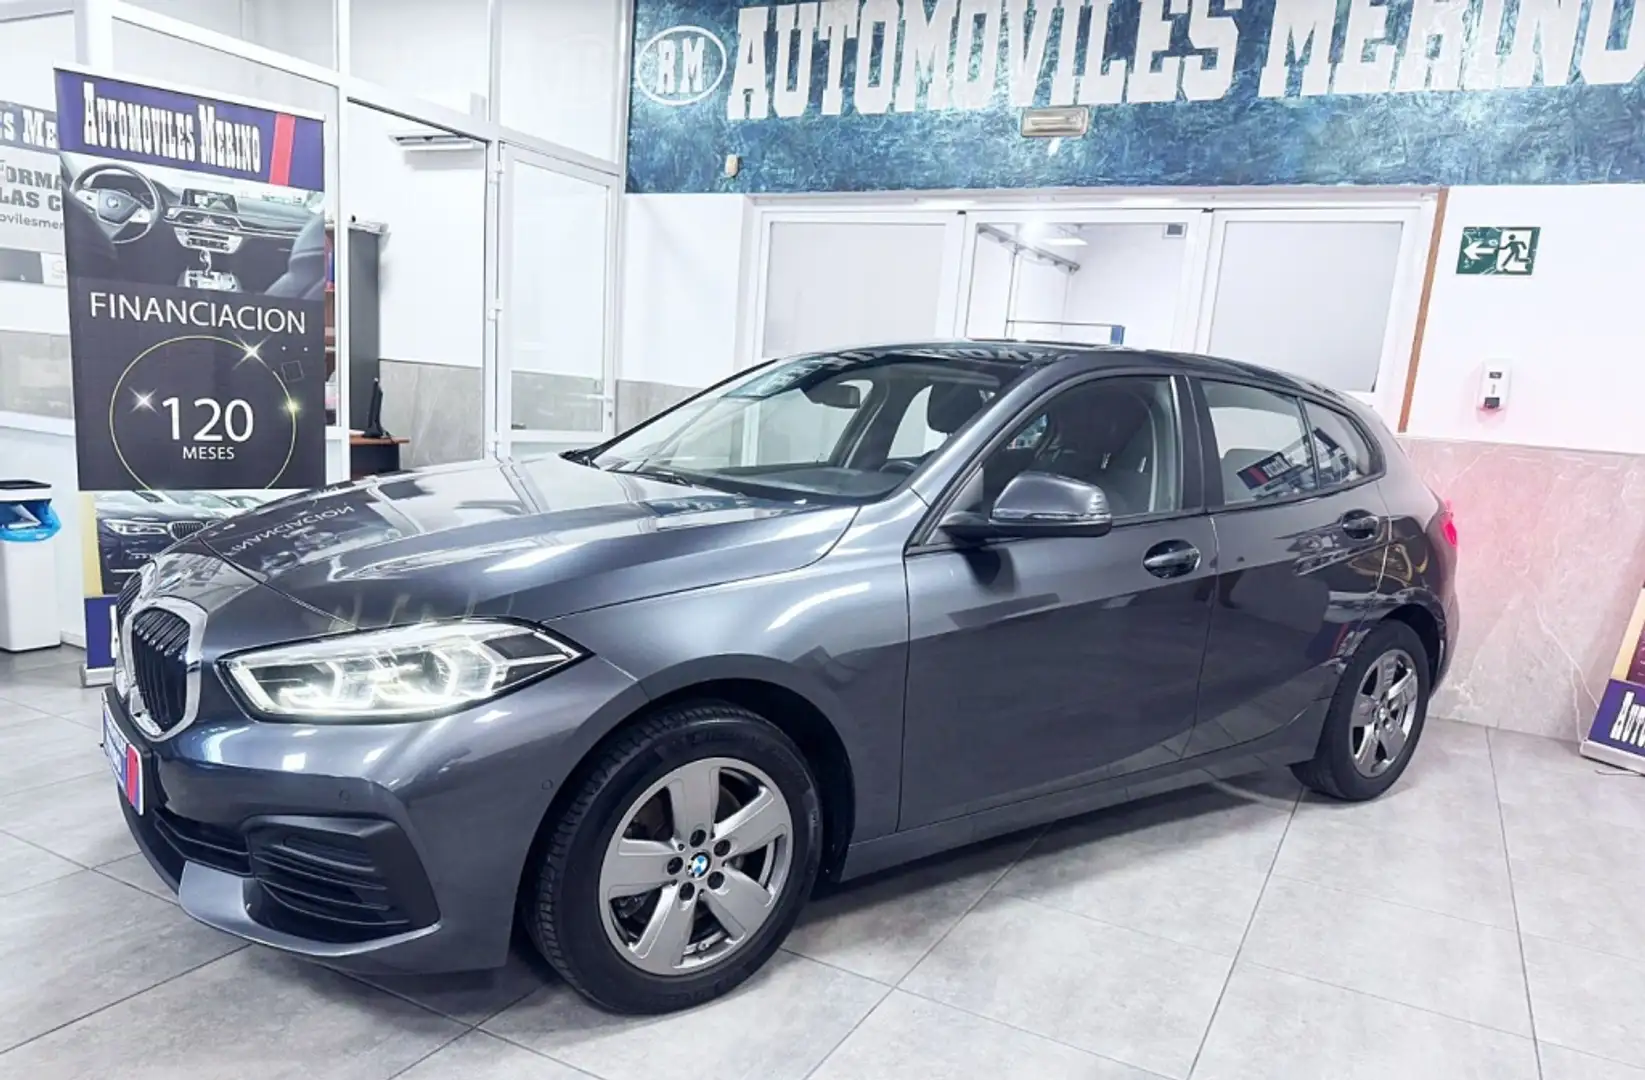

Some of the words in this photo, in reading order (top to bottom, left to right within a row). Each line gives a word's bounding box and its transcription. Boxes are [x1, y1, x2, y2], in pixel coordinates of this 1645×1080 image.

[655, 37, 704, 95] RM
[727, 0, 1239, 119] AUTOMOVILES
[1257, 0, 1645, 98] MERINO
[90, 292, 305, 335] FINANCIACION
[162, 397, 254, 442] 120
[183, 446, 235, 460] MESES
